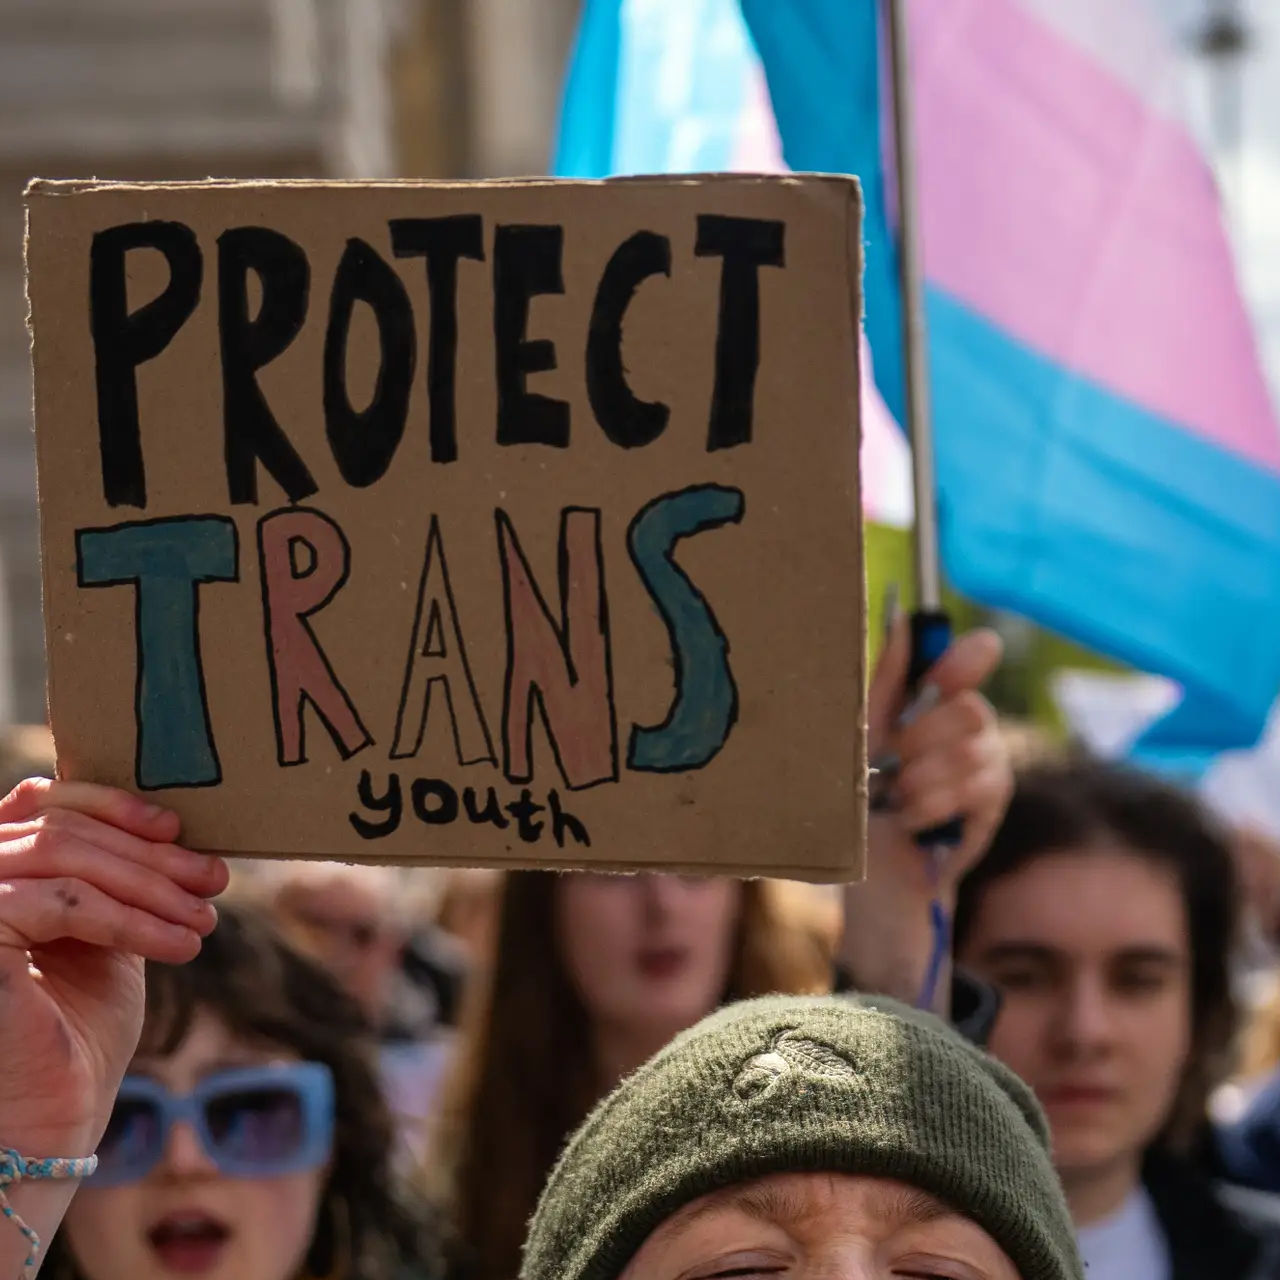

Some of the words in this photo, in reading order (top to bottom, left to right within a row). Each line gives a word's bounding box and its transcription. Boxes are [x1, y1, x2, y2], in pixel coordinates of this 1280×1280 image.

[88, 214, 787, 509] PROTECT
[74, 482, 746, 792] TRANS
[349, 768, 592, 848] youth
